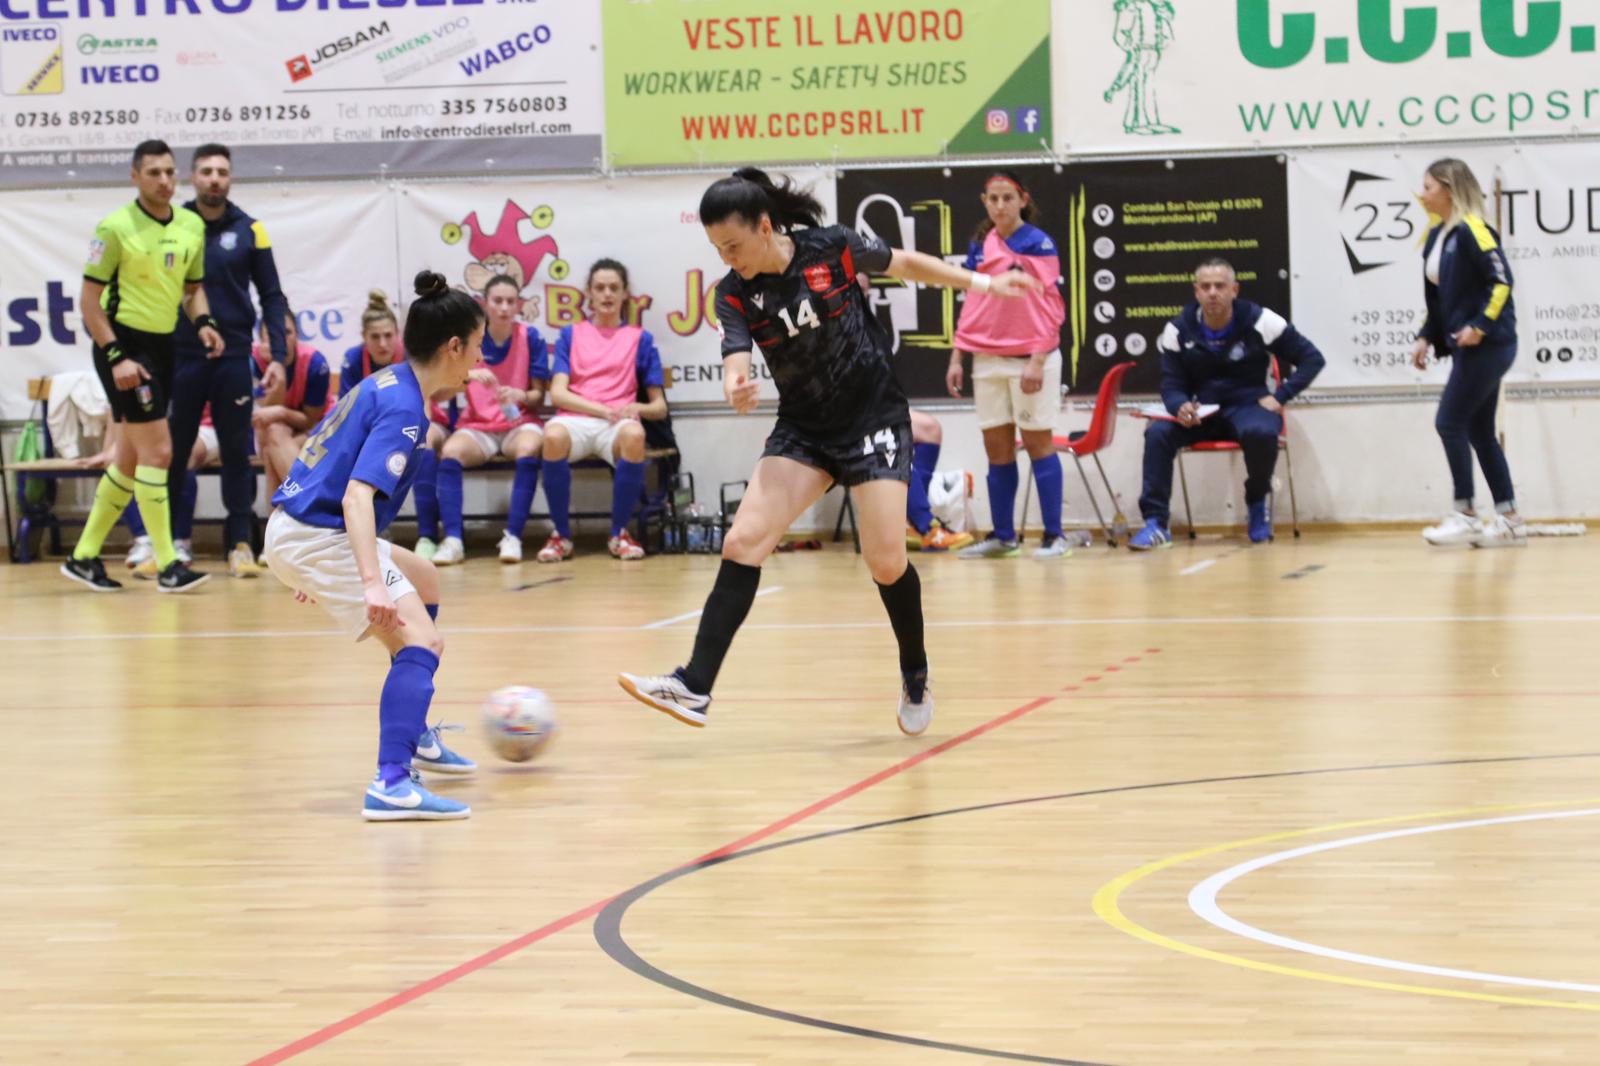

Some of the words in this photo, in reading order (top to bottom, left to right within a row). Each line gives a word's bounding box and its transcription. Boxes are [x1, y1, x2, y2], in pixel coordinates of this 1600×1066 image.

[3, 28, 57, 41] IVECO
[375, 32, 433, 64] SIEMENS
[432, 15, 470, 39] VDO
[684, 17, 781, 50] VESTE
[836, 9, 963, 46] LAVORO
[101, 37, 158, 48] ASTRA
[310, 20, 391, 64] JOSAM
[459, 24, 551, 77] WABCO
[81, 64, 159, 84] IVECO
[624, 69, 761, 96] WORKWEAR
[790, 64, 878, 91] SAFETY
[889, 61, 968, 87] SHOES
[15, 112, 61, 127] 0736
[69, 110, 139, 126] 892580
[154, 107, 181, 124] Fax
[185, 108, 232, 122] 0736
[240, 105, 310, 121] 891256
[368, 104, 435, 119] notturno
[441, 100, 475, 115] 335
[484, 96, 568, 113] 7560803
[381, 122, 571, 139] info@centrodieselsrl.com
[682, 108, 925, 140] WWW.CCCPSRL.IT
[3, 154, 13, 165] A
[16, 152, 54, 165] world
[58, 151, 72, 164] of
[77, 150, 134, 166] transpor
[1122, 202, 1165, 213] Contrada
[1167, 201, 1185, 212] San
[1187, 199, 1220, 211] Donato
[1123, 213, 1194, 226] Monteprandone
[1197, 211, 1217, 225] (AP)
[1354, 201, 1414, 242] 23
[778, 298, 822, 338] 14
[1352, 310, 1380, 325] +39
[1385, 310, 1415, 325] 329
[1352, 331, 1380, 346] +39
[1386, 331, 1416, 345] 320
[1353, 352, 1381, 367] +39
[863, 426, 897, 455] 14
